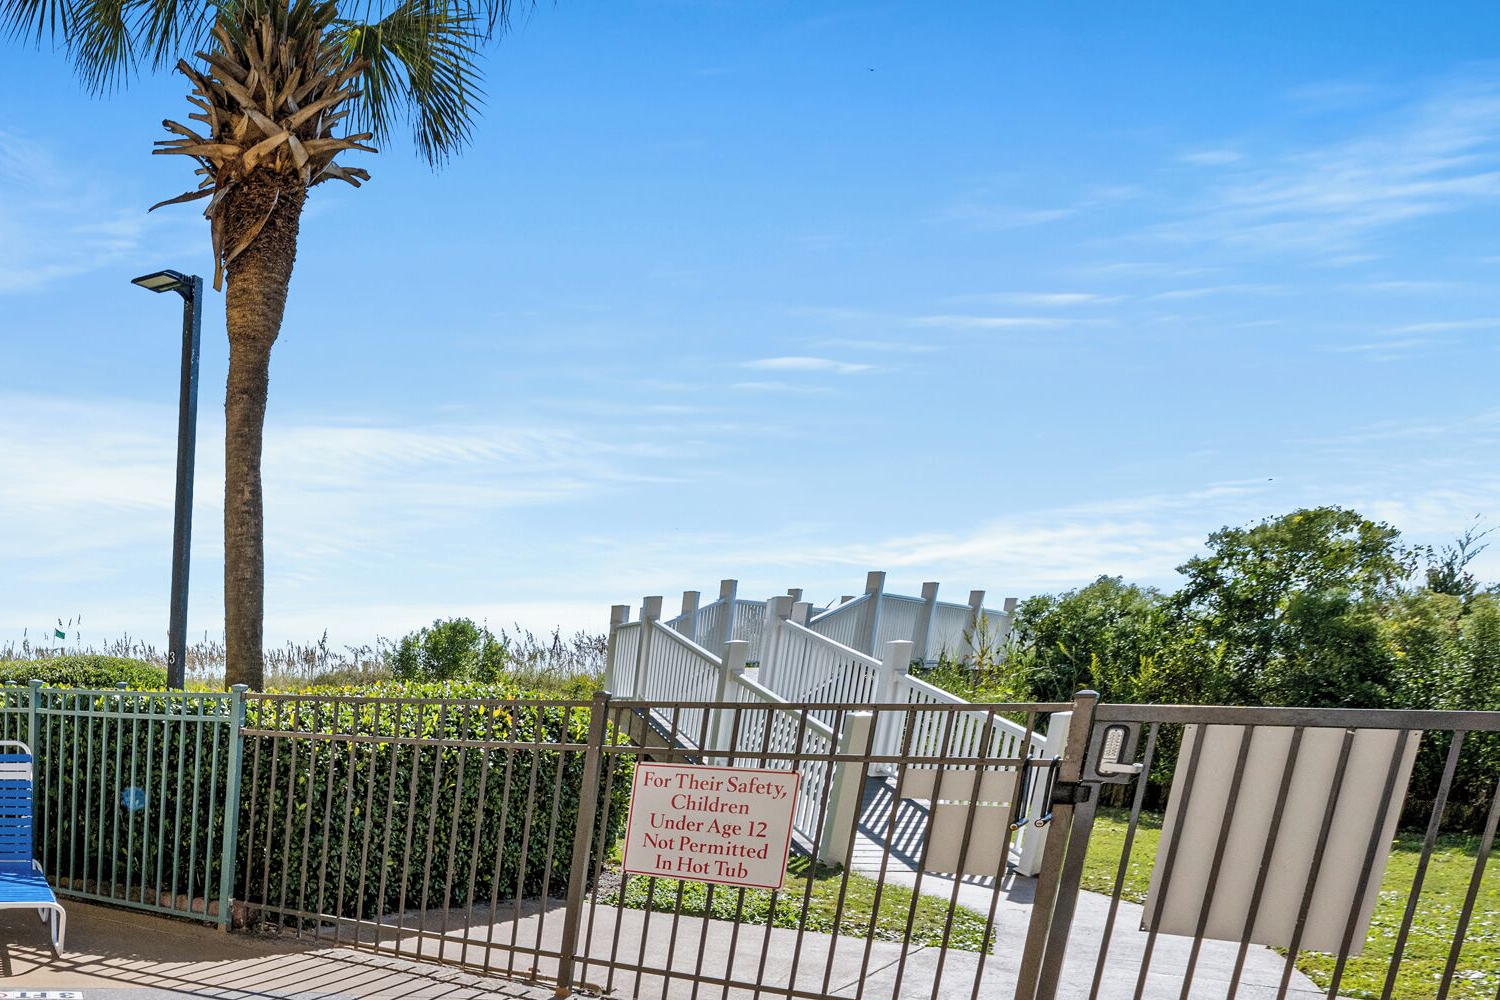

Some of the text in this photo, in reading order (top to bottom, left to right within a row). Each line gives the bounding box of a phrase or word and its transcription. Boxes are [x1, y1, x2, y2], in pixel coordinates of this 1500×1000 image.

[169, 651, 176, 664] 3
[643, 772, 787, 800] For Their Safety,
[671, 794, 749, 814] Children
[650, 813, 767, 838] Under Age 12
[642, 833, 768, 859] Not Permitted
[655, 854, 748, 878] In Hot Tub
